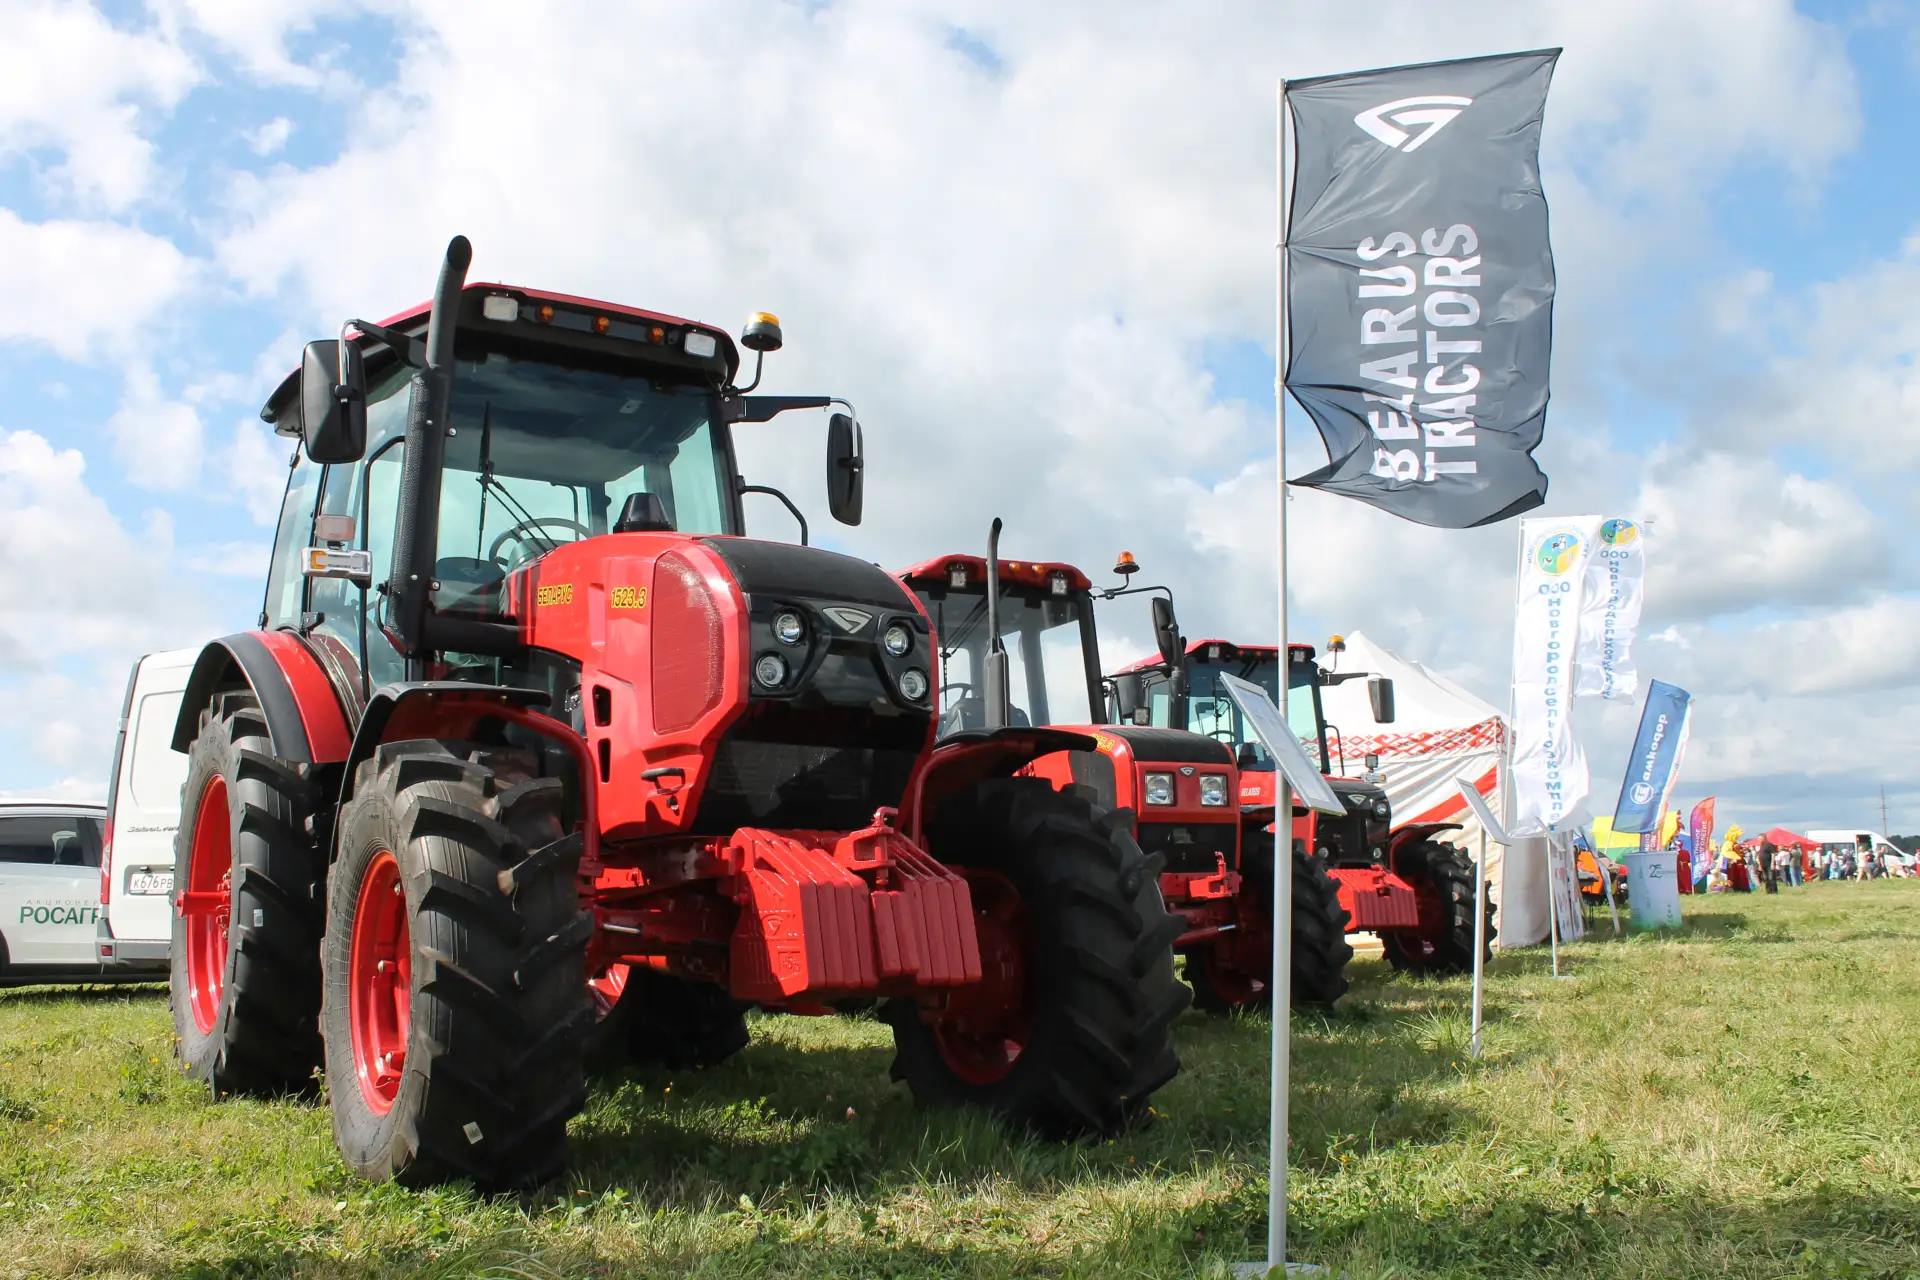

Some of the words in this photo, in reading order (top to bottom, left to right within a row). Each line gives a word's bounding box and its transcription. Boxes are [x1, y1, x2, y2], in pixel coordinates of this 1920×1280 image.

[1356, 231, 1420, 482] BELARUS
[1418, 223, 1482, 482] TRACTORS
[537, 583, 573, 606] БЕЛАРУС
[611, 586, 648, 609] 1523.3
